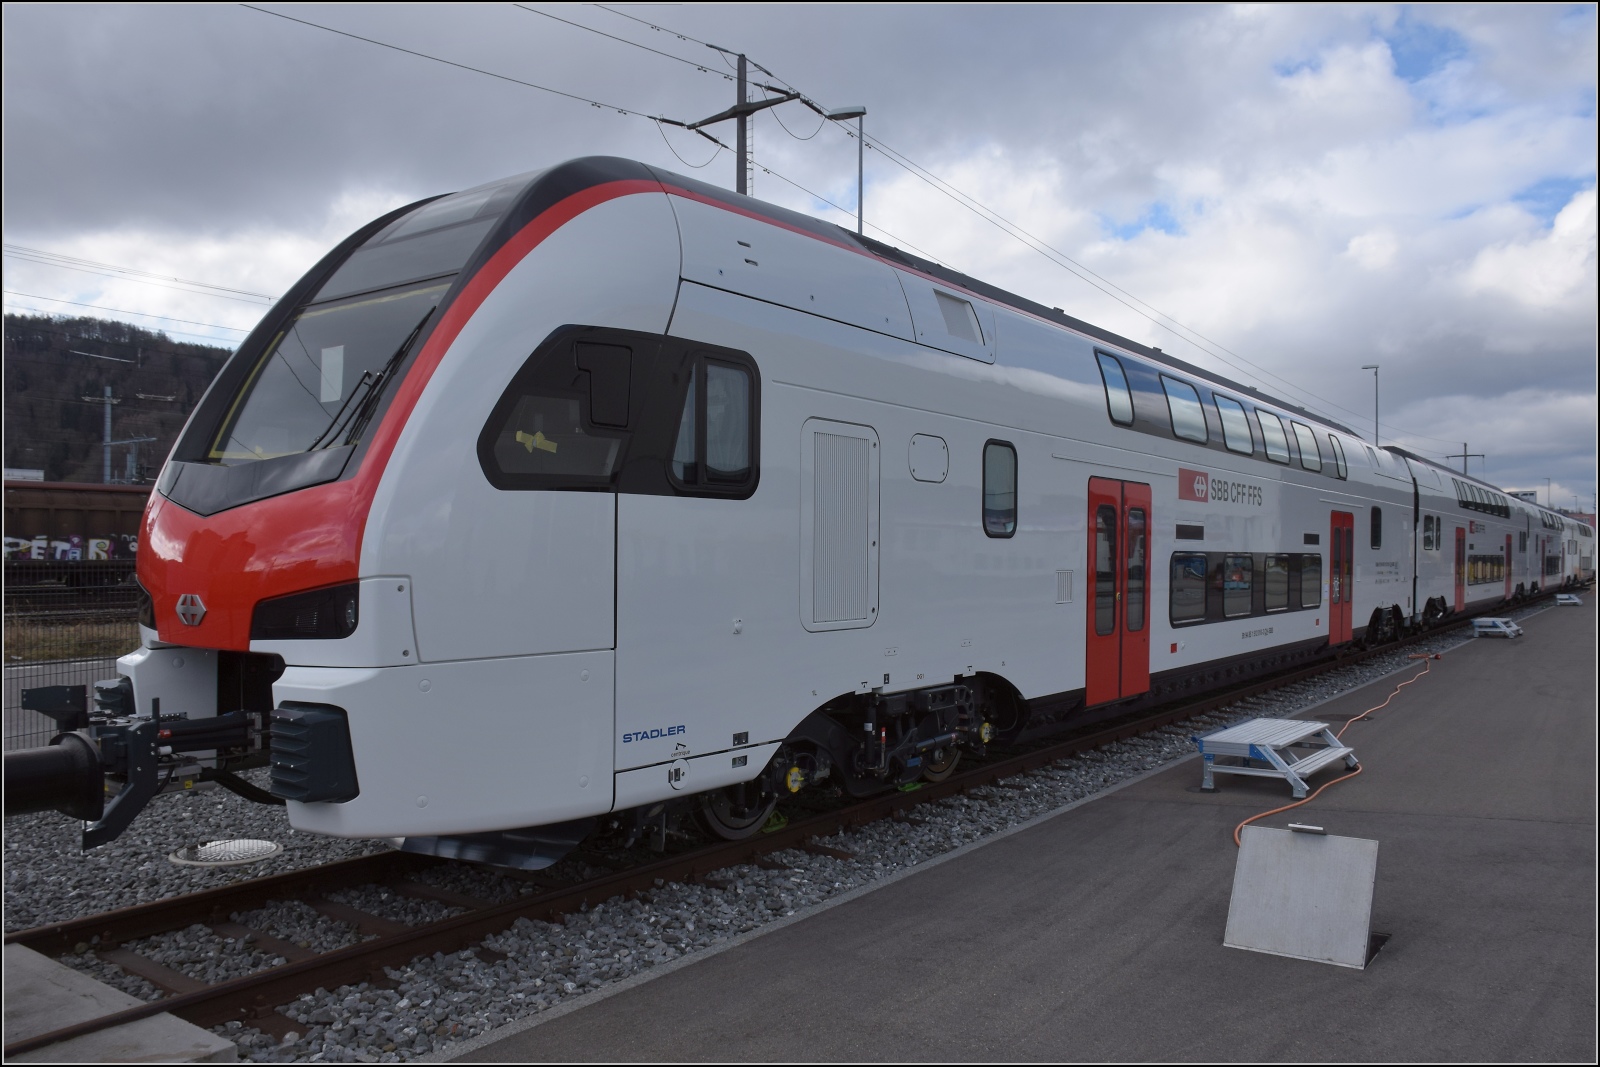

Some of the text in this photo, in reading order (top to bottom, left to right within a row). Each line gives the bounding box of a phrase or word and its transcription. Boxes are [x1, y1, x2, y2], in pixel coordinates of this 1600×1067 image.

[1211, 478, 1263, 507] SBB CFF FFS
[623, 725, 686, 743] STADLER
